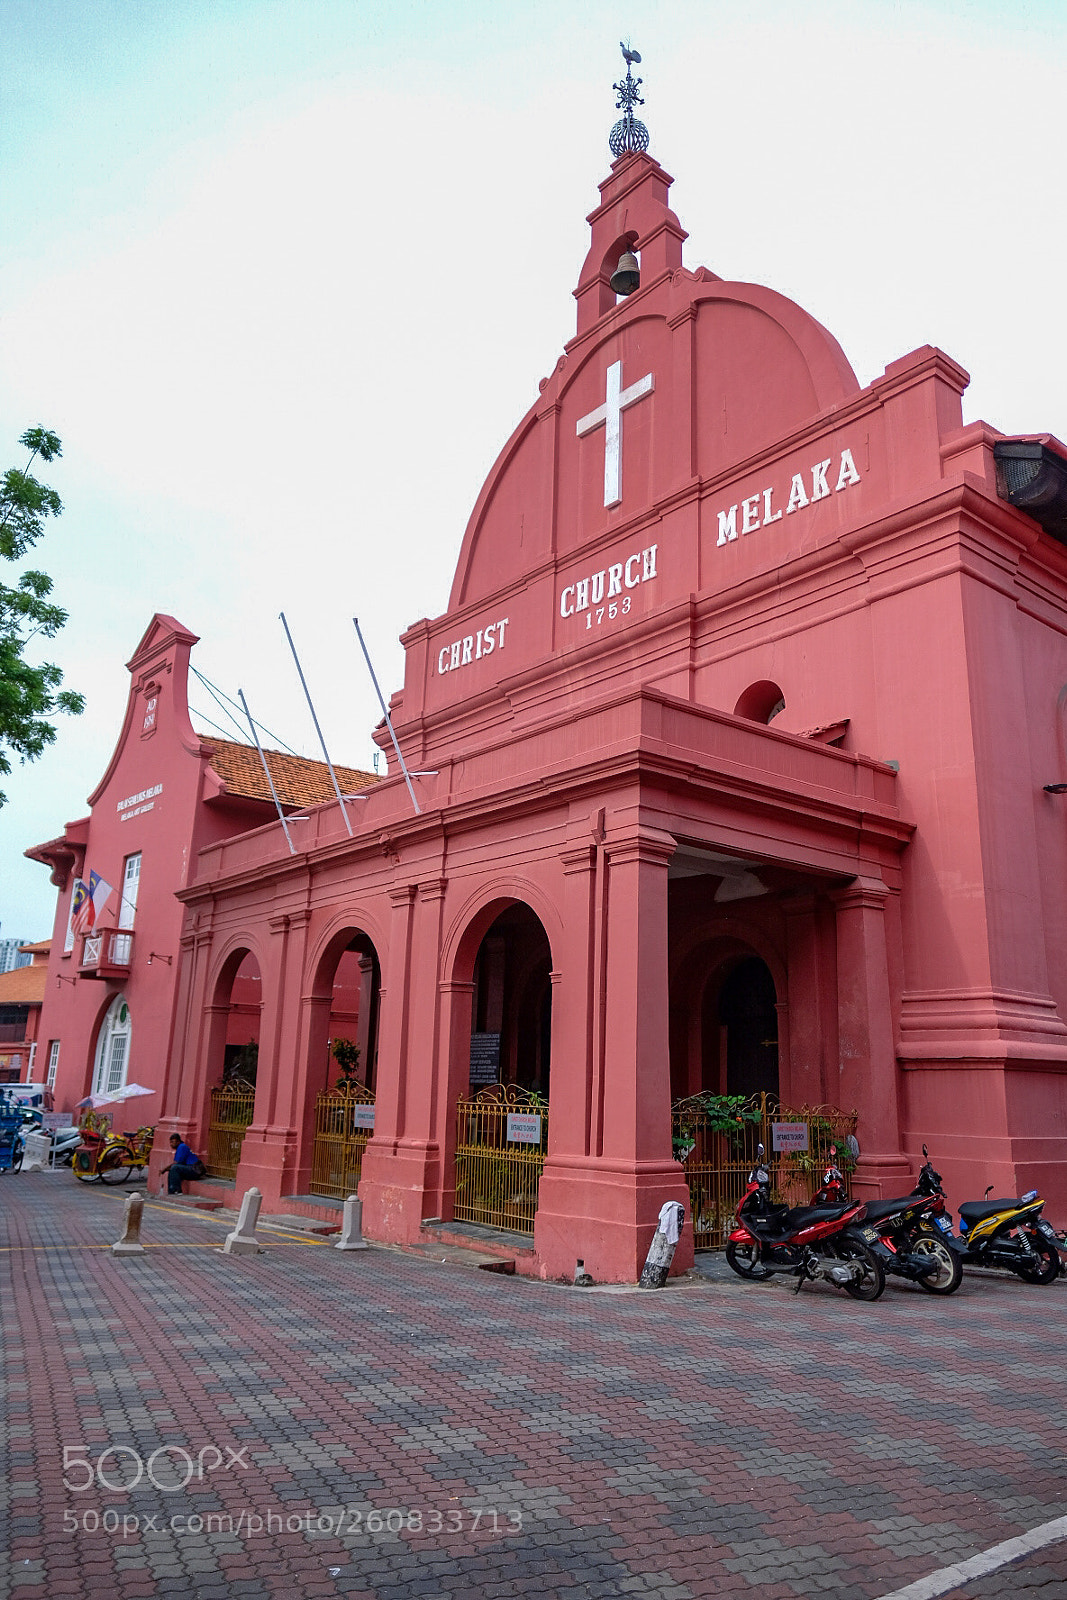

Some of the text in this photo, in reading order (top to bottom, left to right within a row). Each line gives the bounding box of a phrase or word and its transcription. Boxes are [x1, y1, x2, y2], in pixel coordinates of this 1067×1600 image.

[438, 448, 862, 675] CHRIST CHURCH MELAKA
[585, 596, 633, 630] 1753
